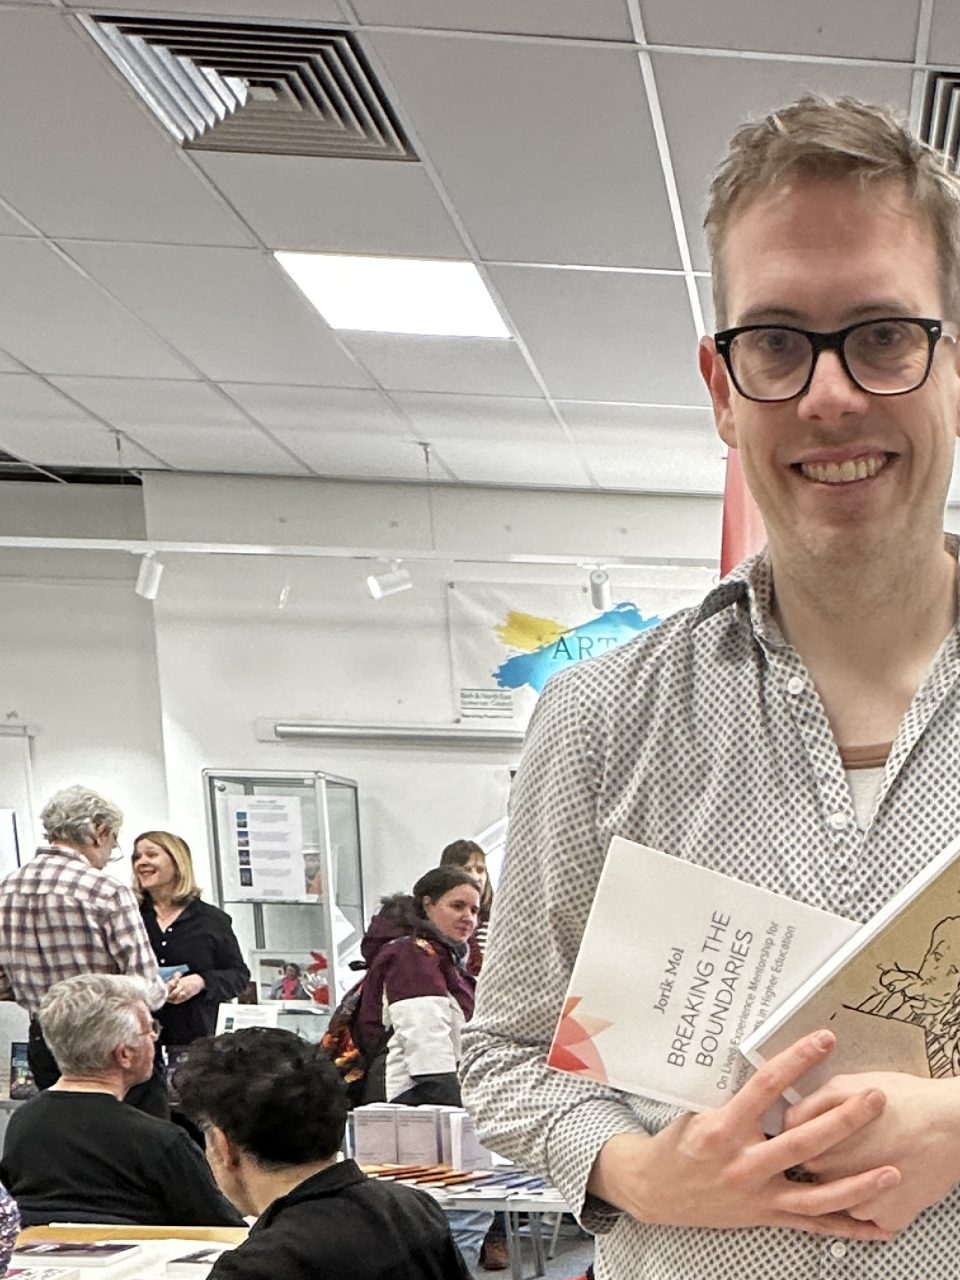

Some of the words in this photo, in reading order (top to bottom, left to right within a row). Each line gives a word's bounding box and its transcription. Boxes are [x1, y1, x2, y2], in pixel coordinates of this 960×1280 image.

[653, 978, 675, 1014] Jorik
[666, 947, 685, 976] Mol
[667, 960, 714, 1067] BREAKING
[701, 910, 731, 953] THE
[696, 928, 753, 1067] BOUNDARIES
[717, 1076, 728, 1090] On
[748, 935, 775, 990] Mentorship
[769, 921, 780, 936] for
[762, 976, 779, 1008] Higher
[773, 925, 796, 974] Education
